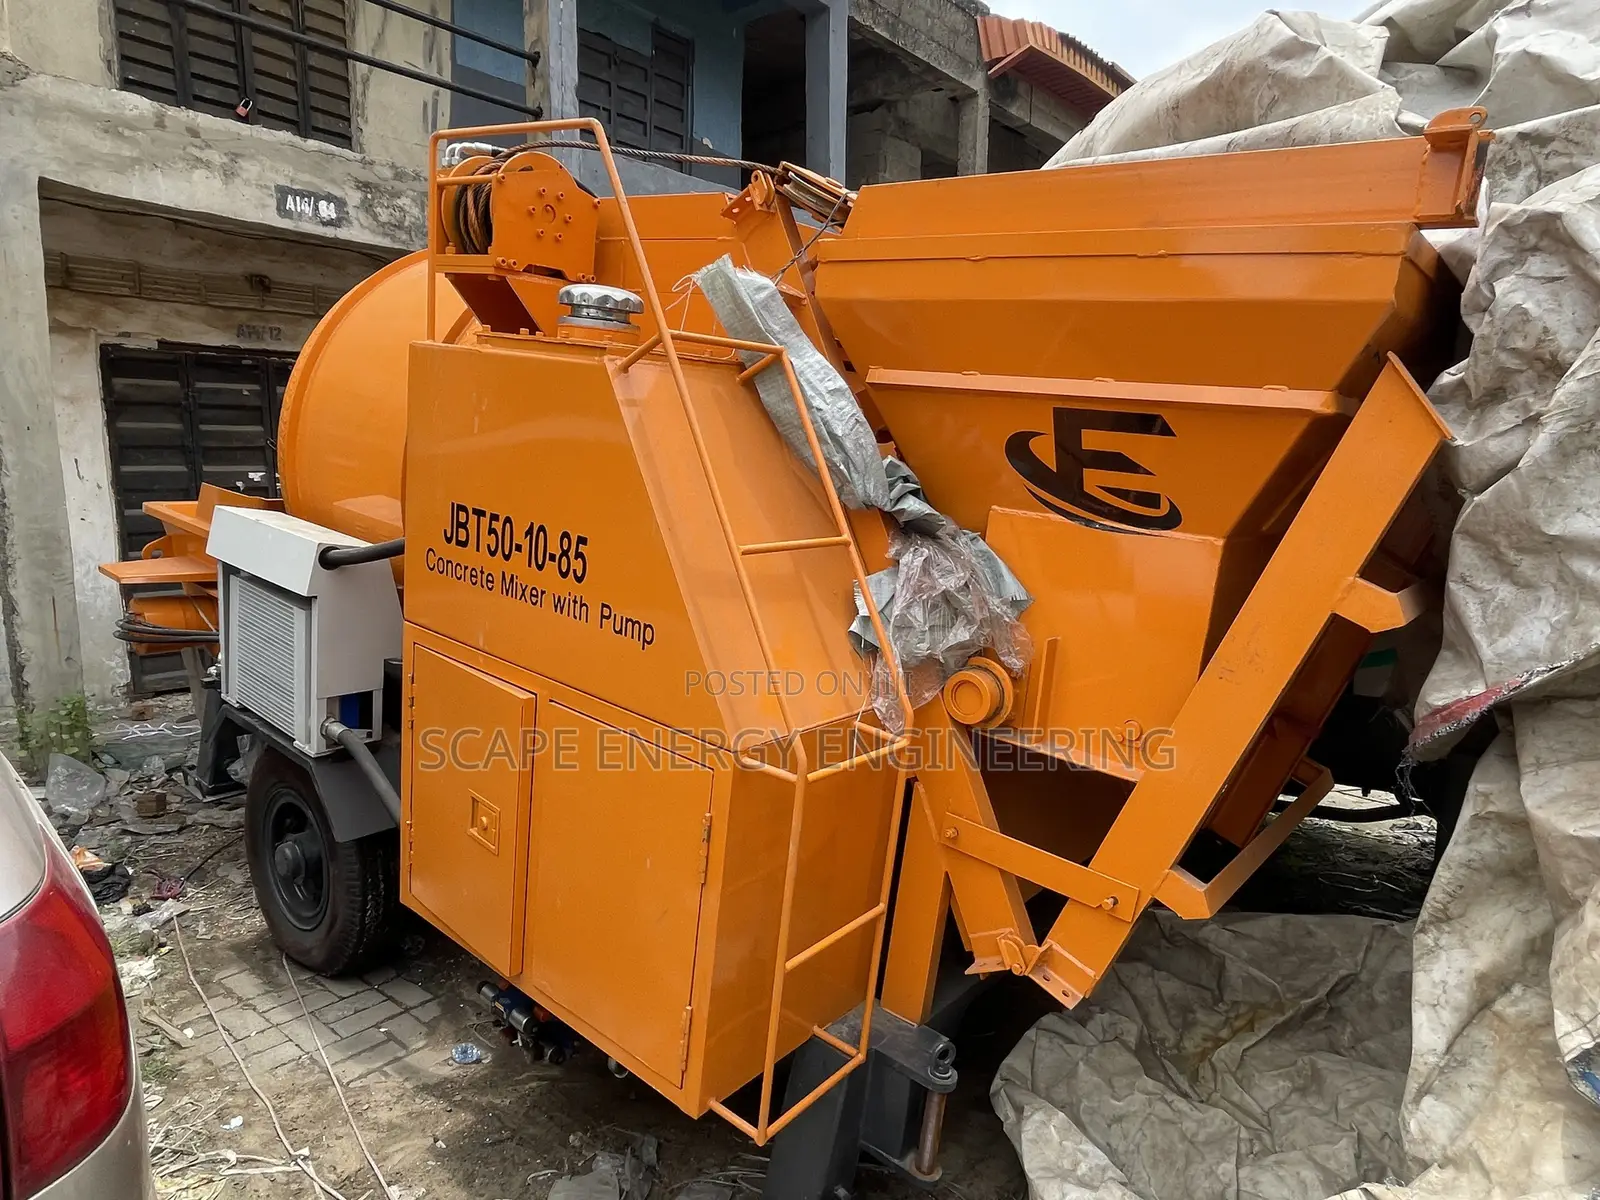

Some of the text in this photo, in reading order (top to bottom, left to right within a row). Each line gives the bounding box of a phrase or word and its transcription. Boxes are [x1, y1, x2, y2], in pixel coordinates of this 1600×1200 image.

[443, 501, 588, 584] JBT50-10-85
[426, 547, 655, 650] Concrete Mixer with Pump
